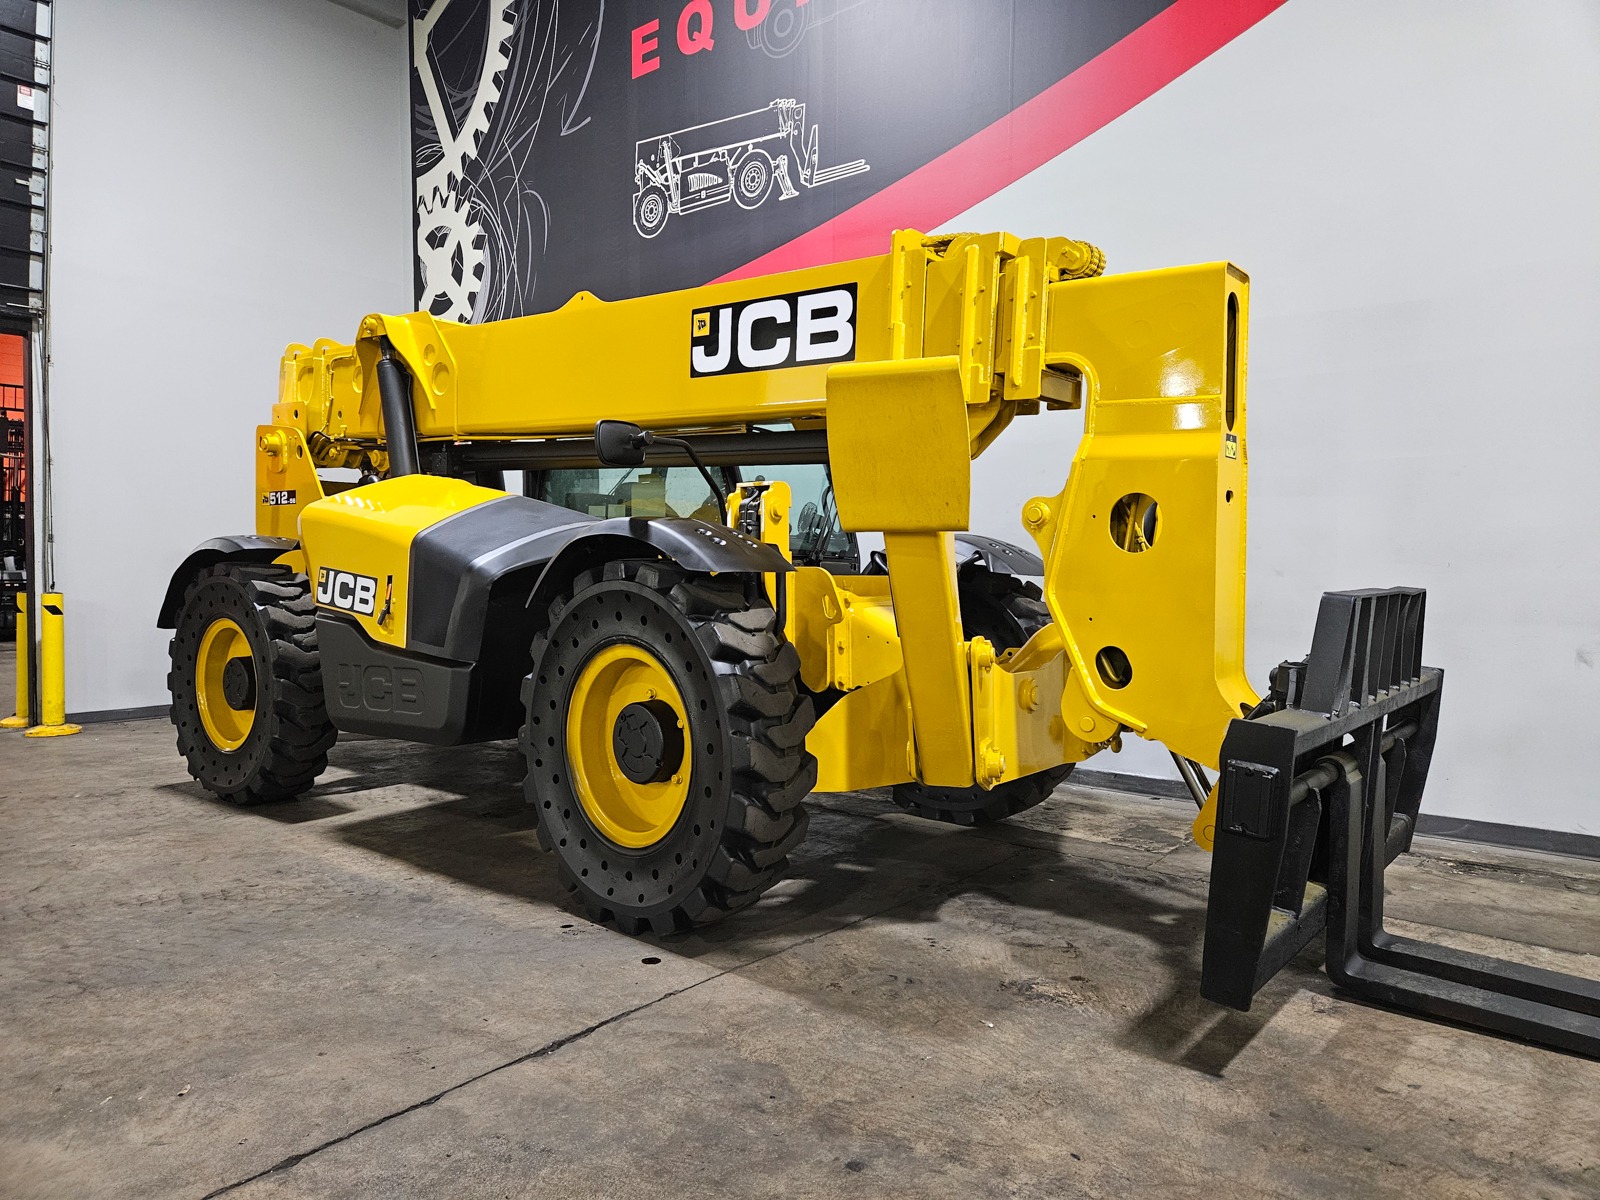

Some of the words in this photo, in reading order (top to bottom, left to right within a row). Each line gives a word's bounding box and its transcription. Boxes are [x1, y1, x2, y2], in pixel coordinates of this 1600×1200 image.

[632, 0, 810, 79] EQU
[692, 289, 853, 373] JCB
[317, 570, 376, 614] JCB
[338, 663, 425, 714] JCB
